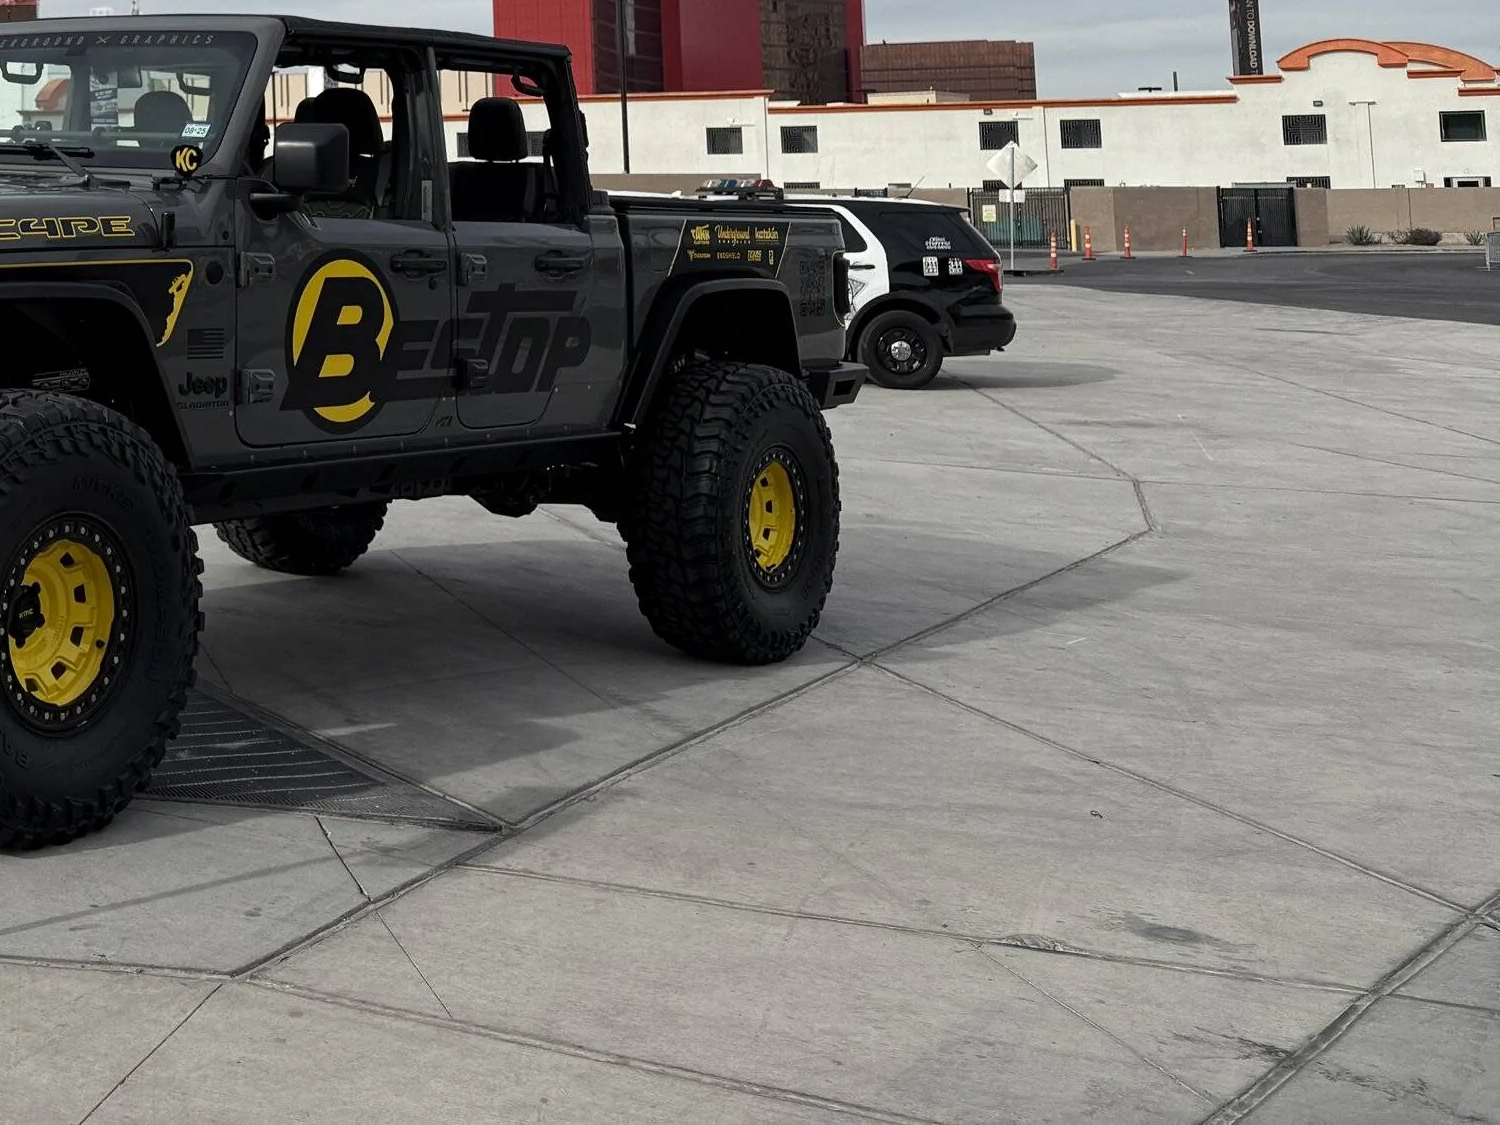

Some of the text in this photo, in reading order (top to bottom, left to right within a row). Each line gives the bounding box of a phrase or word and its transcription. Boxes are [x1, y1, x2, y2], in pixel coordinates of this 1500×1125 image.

[1246, 8, 1256, 20] TO
[119, 34, 215, 46] GRAPHICS
[1247, 21, 1258, 68] DOWNLOAD
[175, 147, 198, 172] KC
[178, 372, 228, 398] Jeep
